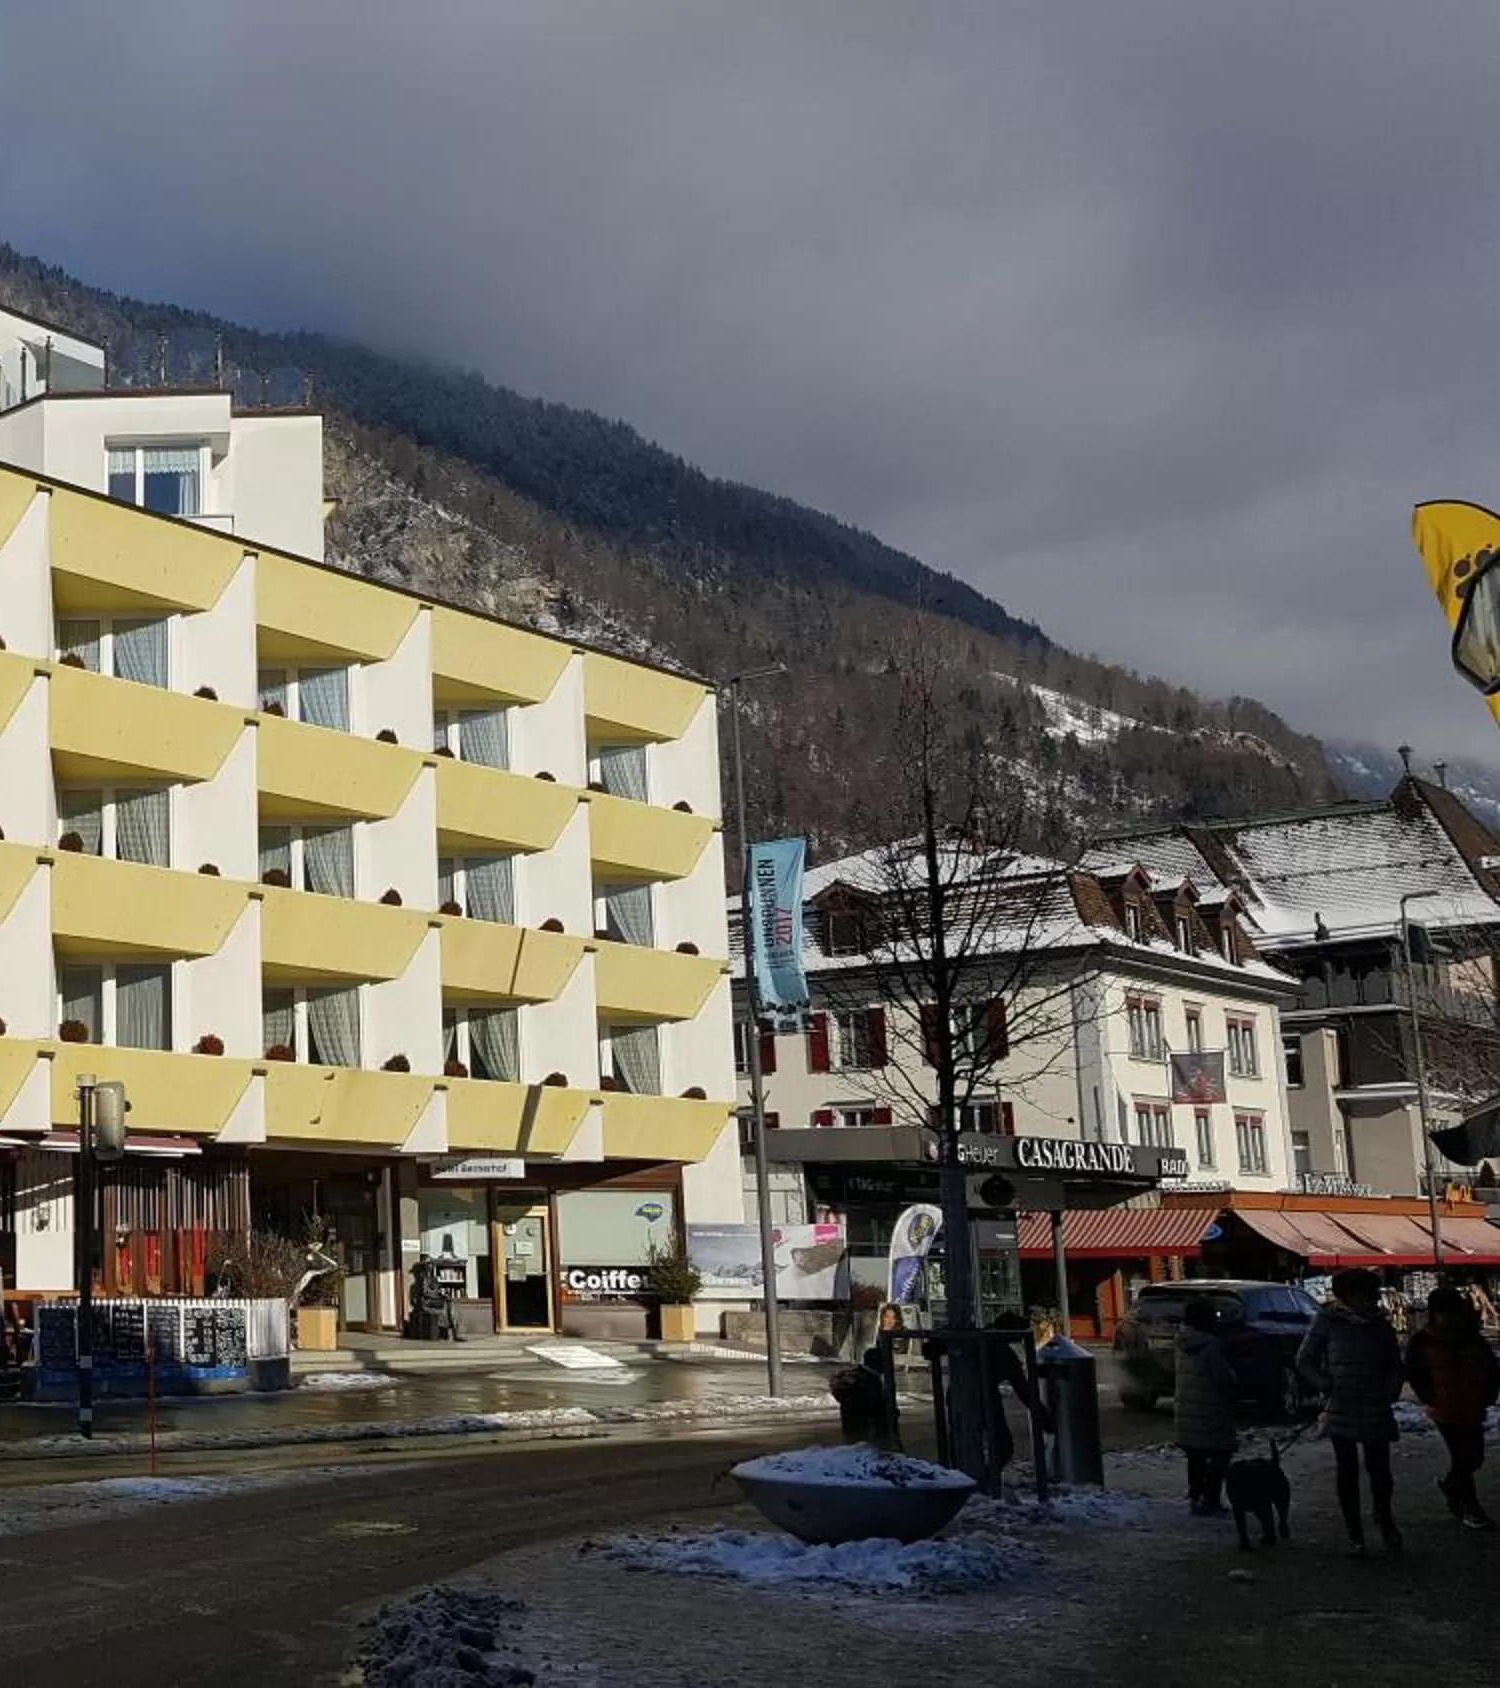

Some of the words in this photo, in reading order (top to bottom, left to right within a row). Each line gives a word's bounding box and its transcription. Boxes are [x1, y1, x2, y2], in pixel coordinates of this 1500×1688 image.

[775, 907, 793, 946] 2017
[1018, 1138, 1135, 1173] CASAGRANDE
[569, 1269, 650, 1290] Coiffe
